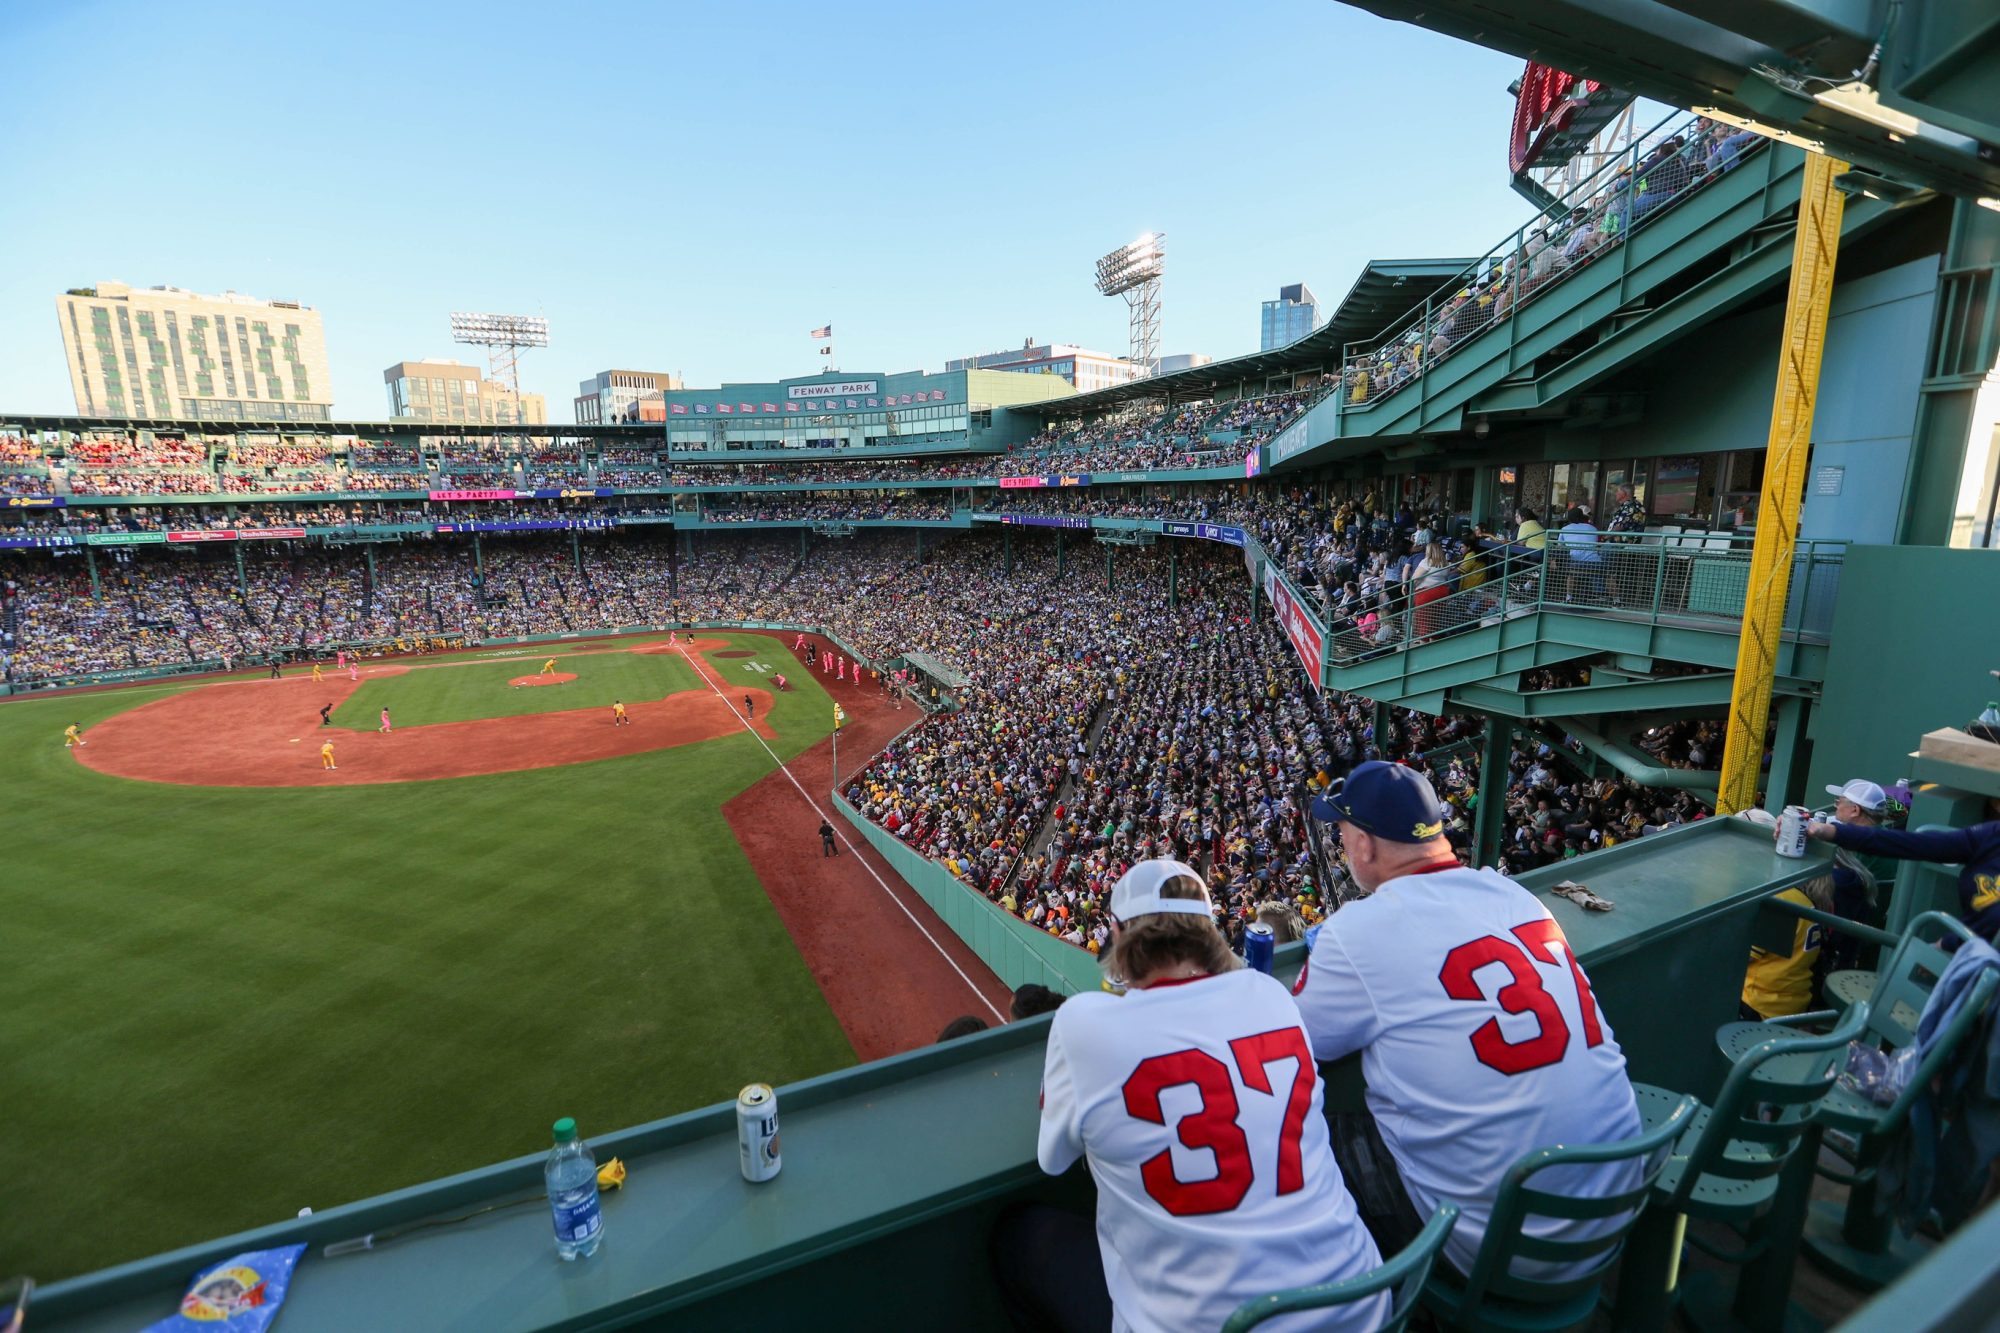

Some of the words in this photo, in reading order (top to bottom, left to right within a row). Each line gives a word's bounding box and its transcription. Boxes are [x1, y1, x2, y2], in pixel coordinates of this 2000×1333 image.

[794, 386, 836, 396] FENWAY
[842, 383, 871, 393] PARK
[1438, 918, 1604, 1077] 37
[1121, 1025, 1316, 1217] 37
